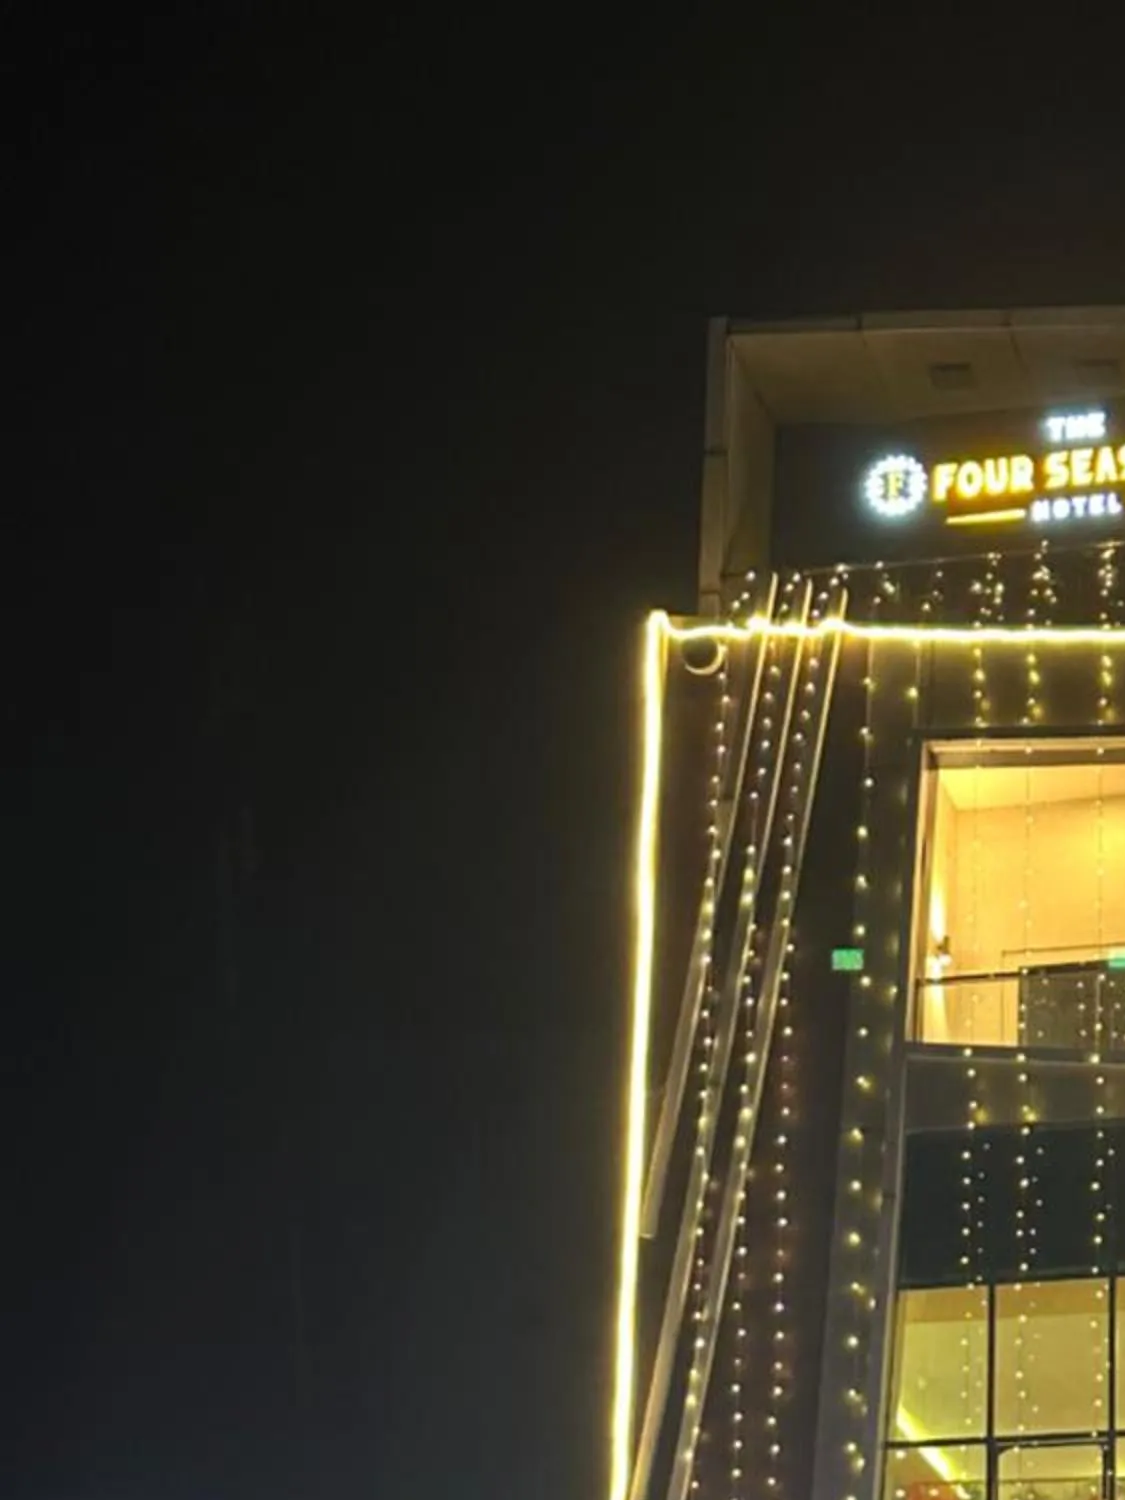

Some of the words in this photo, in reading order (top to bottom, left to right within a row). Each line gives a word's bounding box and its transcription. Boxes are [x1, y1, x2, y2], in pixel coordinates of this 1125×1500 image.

[1046, 412, 1106, 441] THE
[932, 454, 1034, 502] FOUR
[1030, 493, 1122, 523] HOTEL
